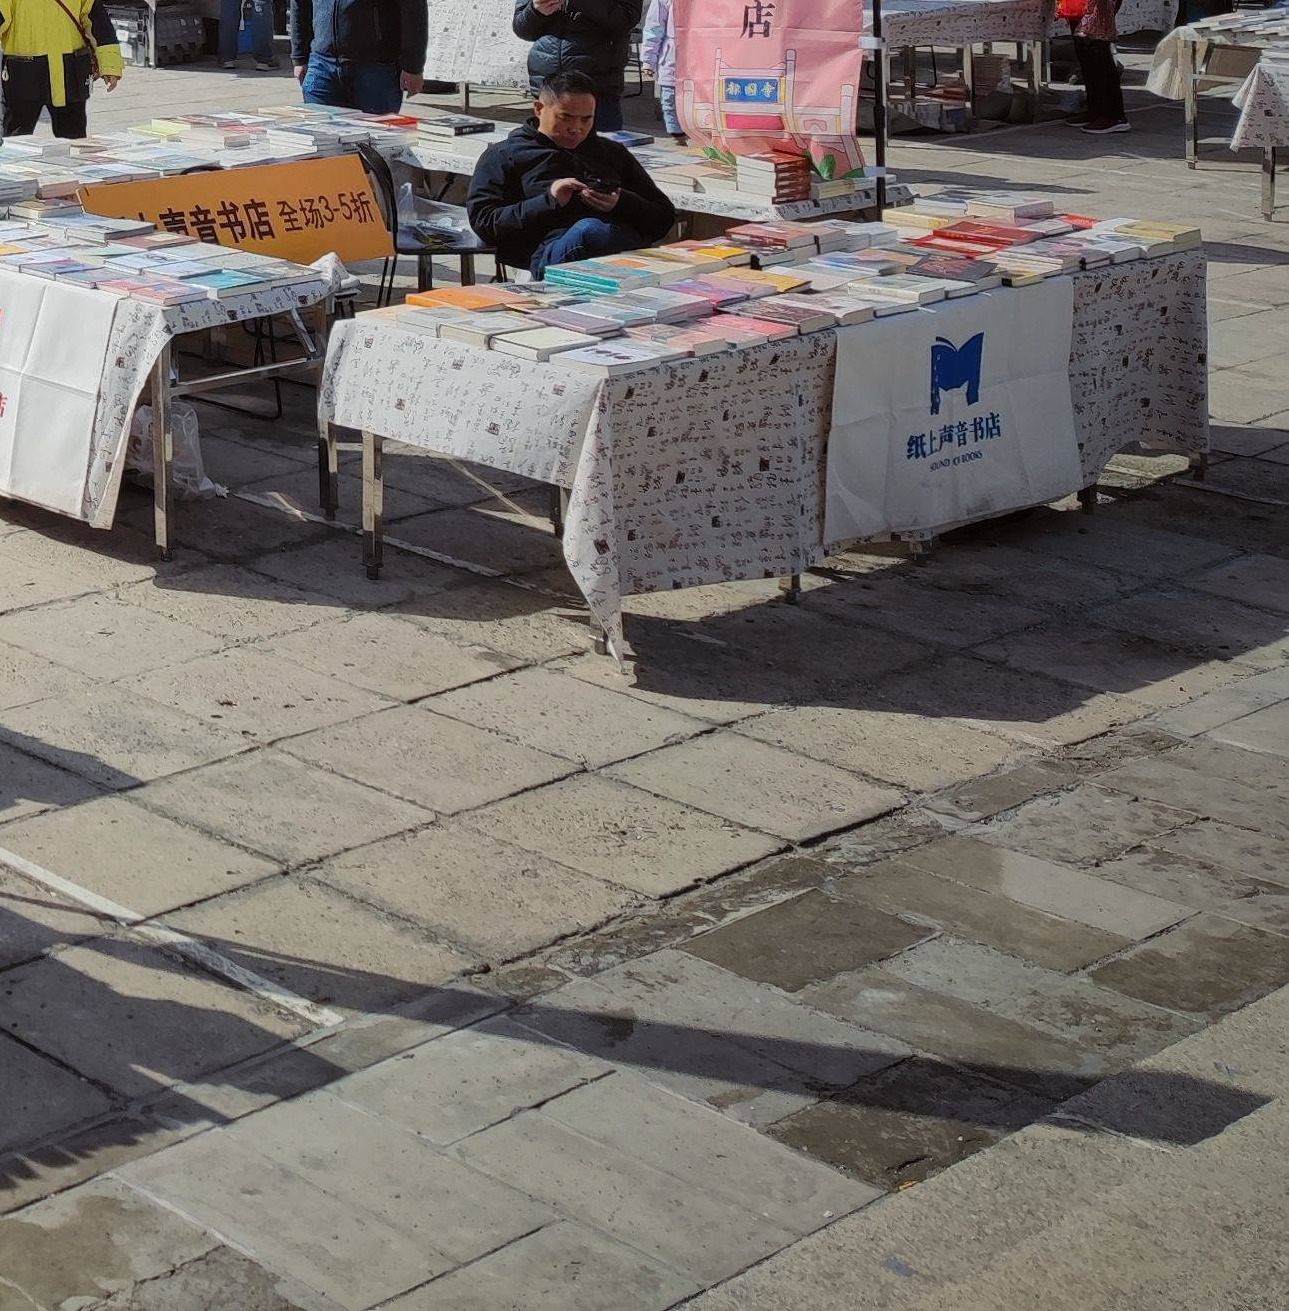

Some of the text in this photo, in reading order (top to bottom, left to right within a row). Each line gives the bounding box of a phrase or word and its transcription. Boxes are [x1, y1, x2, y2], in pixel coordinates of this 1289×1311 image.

[276, 190, 375, 233] 全场3-5折
[906, 411, 1002, 460] 纸上声音书店
